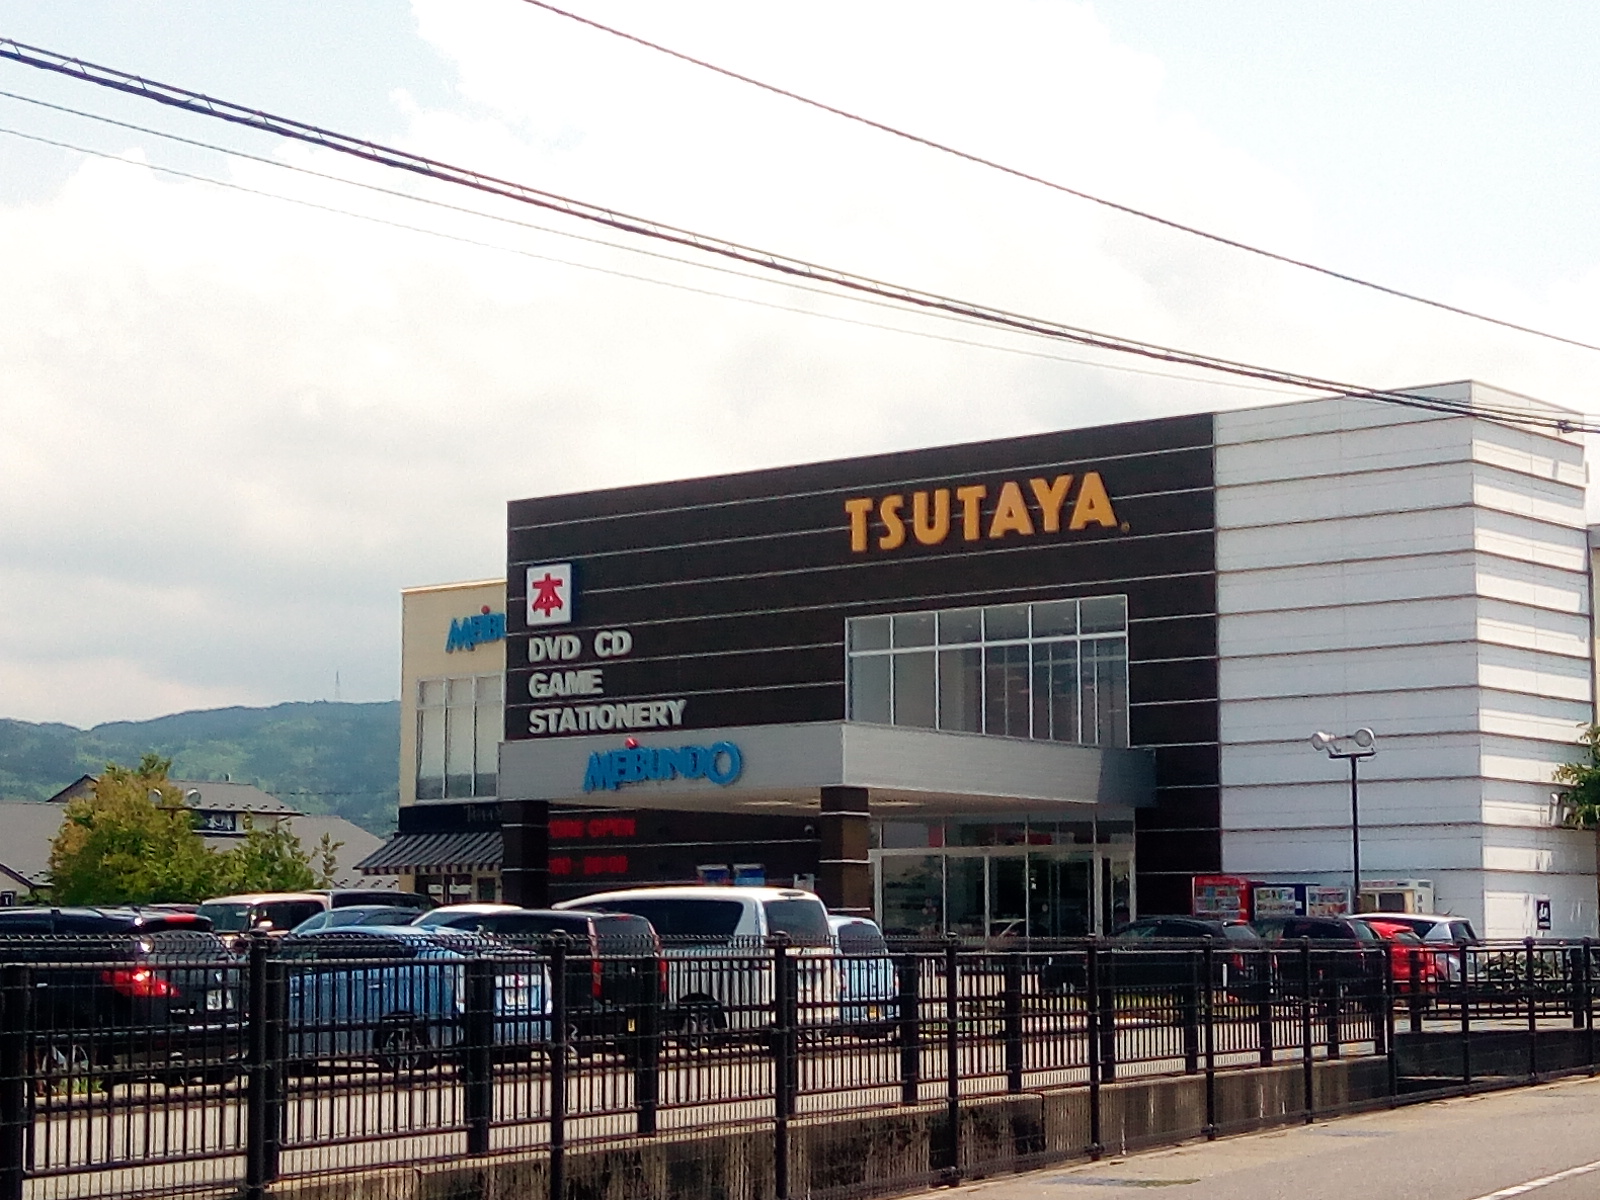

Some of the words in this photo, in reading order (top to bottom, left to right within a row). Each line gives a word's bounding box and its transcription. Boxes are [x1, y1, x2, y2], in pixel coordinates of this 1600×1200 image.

[844, 472, 1118, 551] TSUTAYA
[532, 572, 564, 617] 本
[528, 635, 581, 663] DVD
[594, 630, 633, 658] CD
[528, 669, 603, 698] GAME
[528, 700, 687, 734] STATIONERY
[583, 741, 742, 793] MEBUNDO
